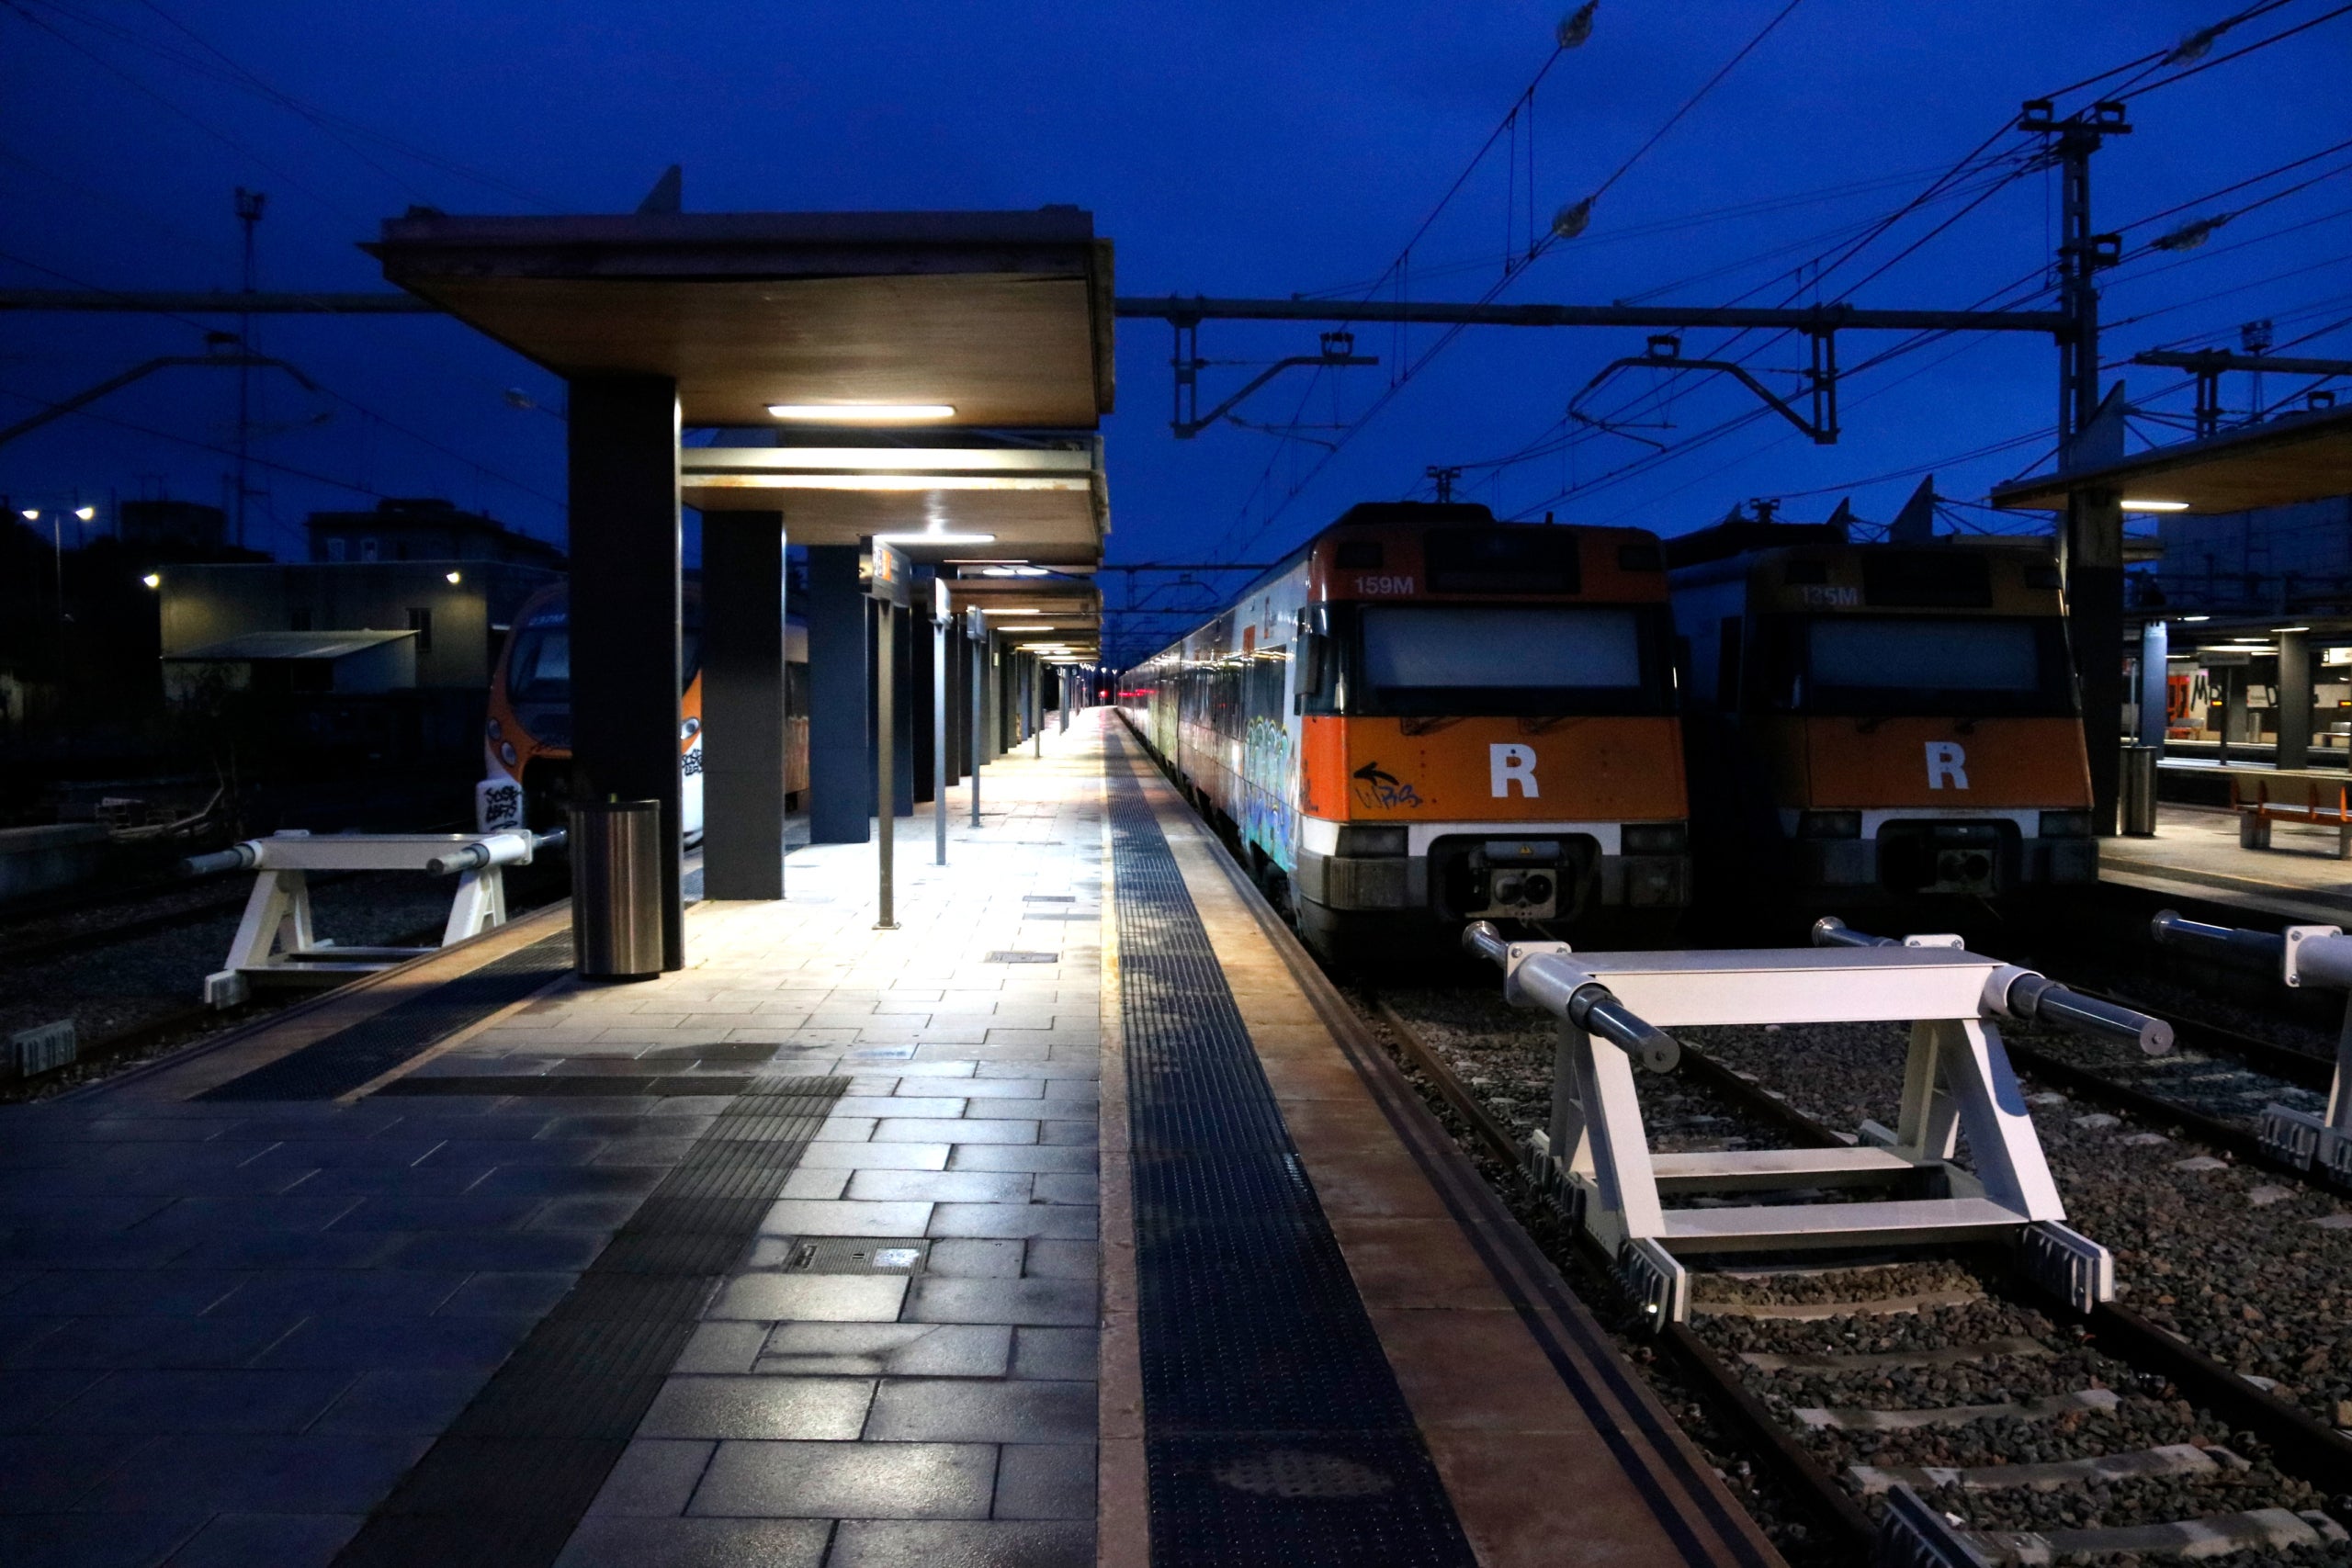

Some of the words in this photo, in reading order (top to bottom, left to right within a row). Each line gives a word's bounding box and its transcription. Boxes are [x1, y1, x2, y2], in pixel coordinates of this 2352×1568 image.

[1354, 576, 1414, 594] 159M
[1489, 742, 1540, 798] R
[1924, 741, 1970, 790] R
